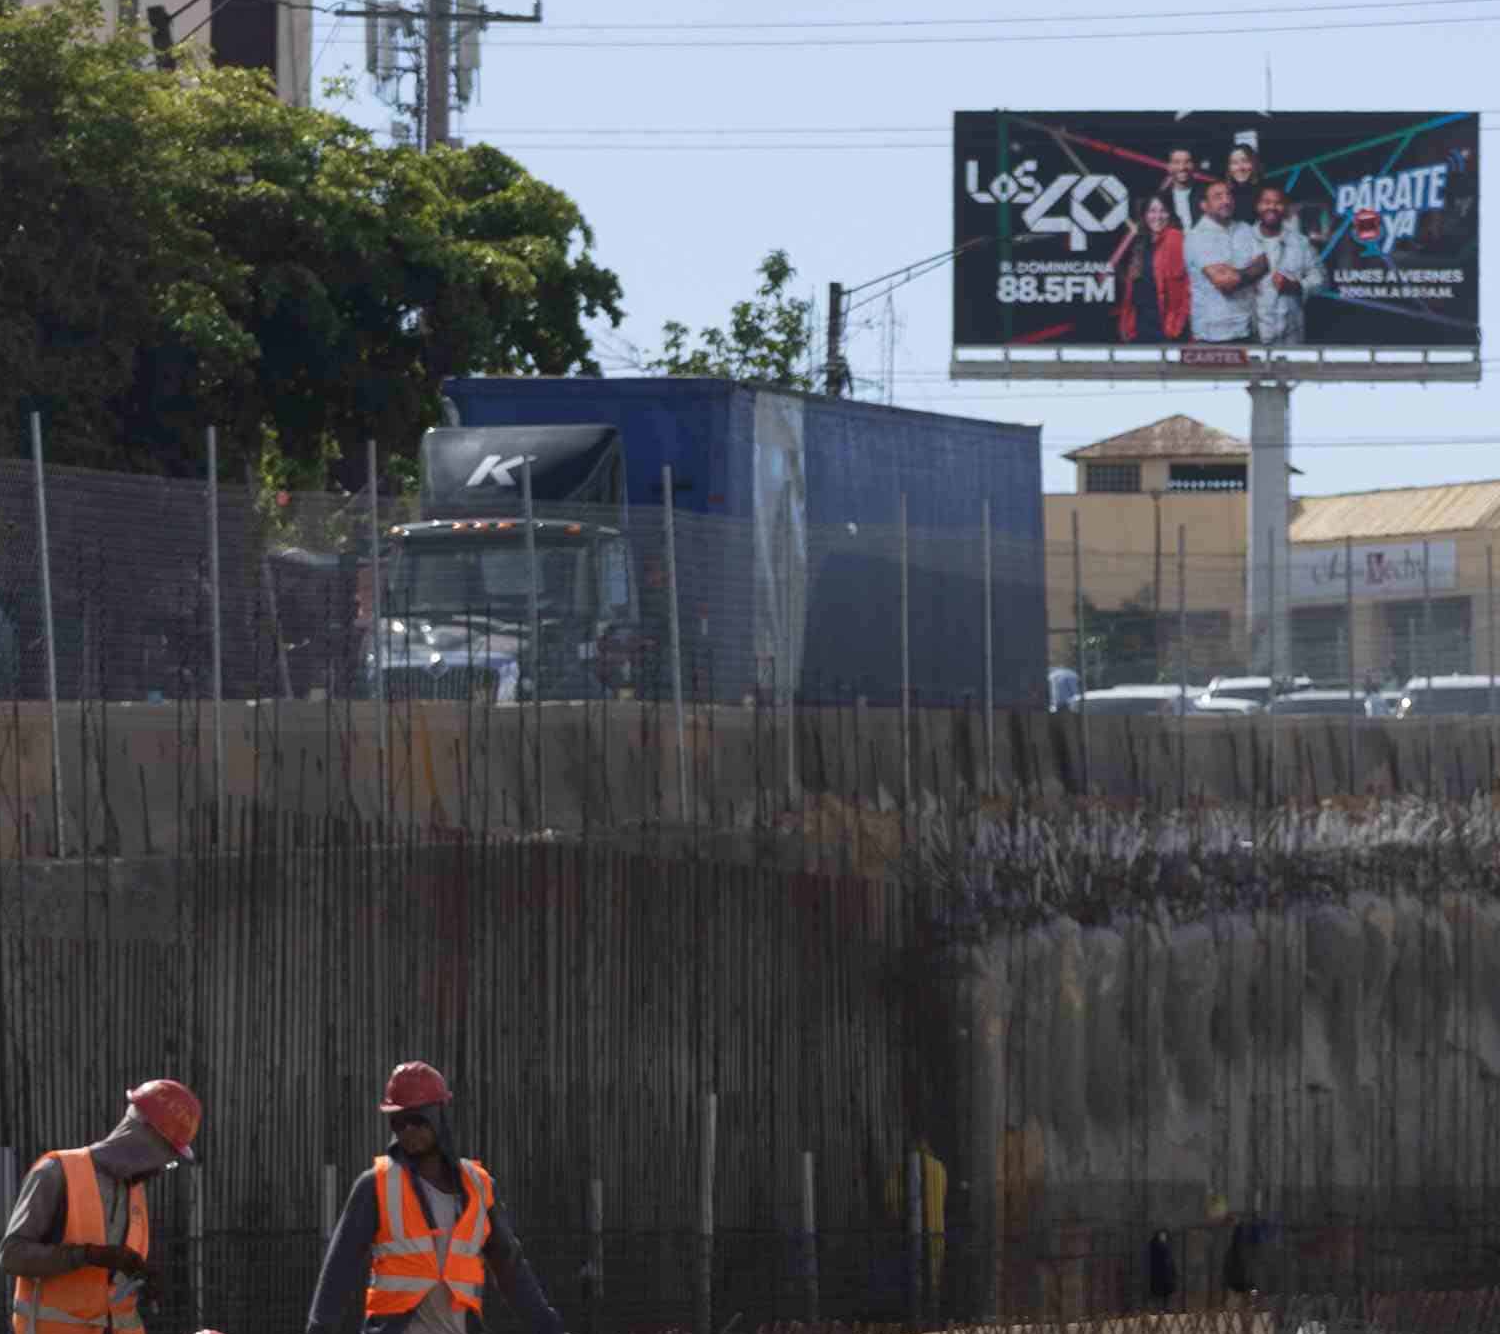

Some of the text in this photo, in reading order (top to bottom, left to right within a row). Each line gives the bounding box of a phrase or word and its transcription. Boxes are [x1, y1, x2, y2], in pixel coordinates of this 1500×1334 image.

[1336, 163, 1448, 214] PÁRATE
[1021, 174, 1129, 251] 40
[1017, 261, 1115, 274] DOMINICANA
[1333, 269, 1384, 283] LUNES
[1398, 269, 1464, 283] VIERNES
[997, 275, 1115, 303] 88.5FM
